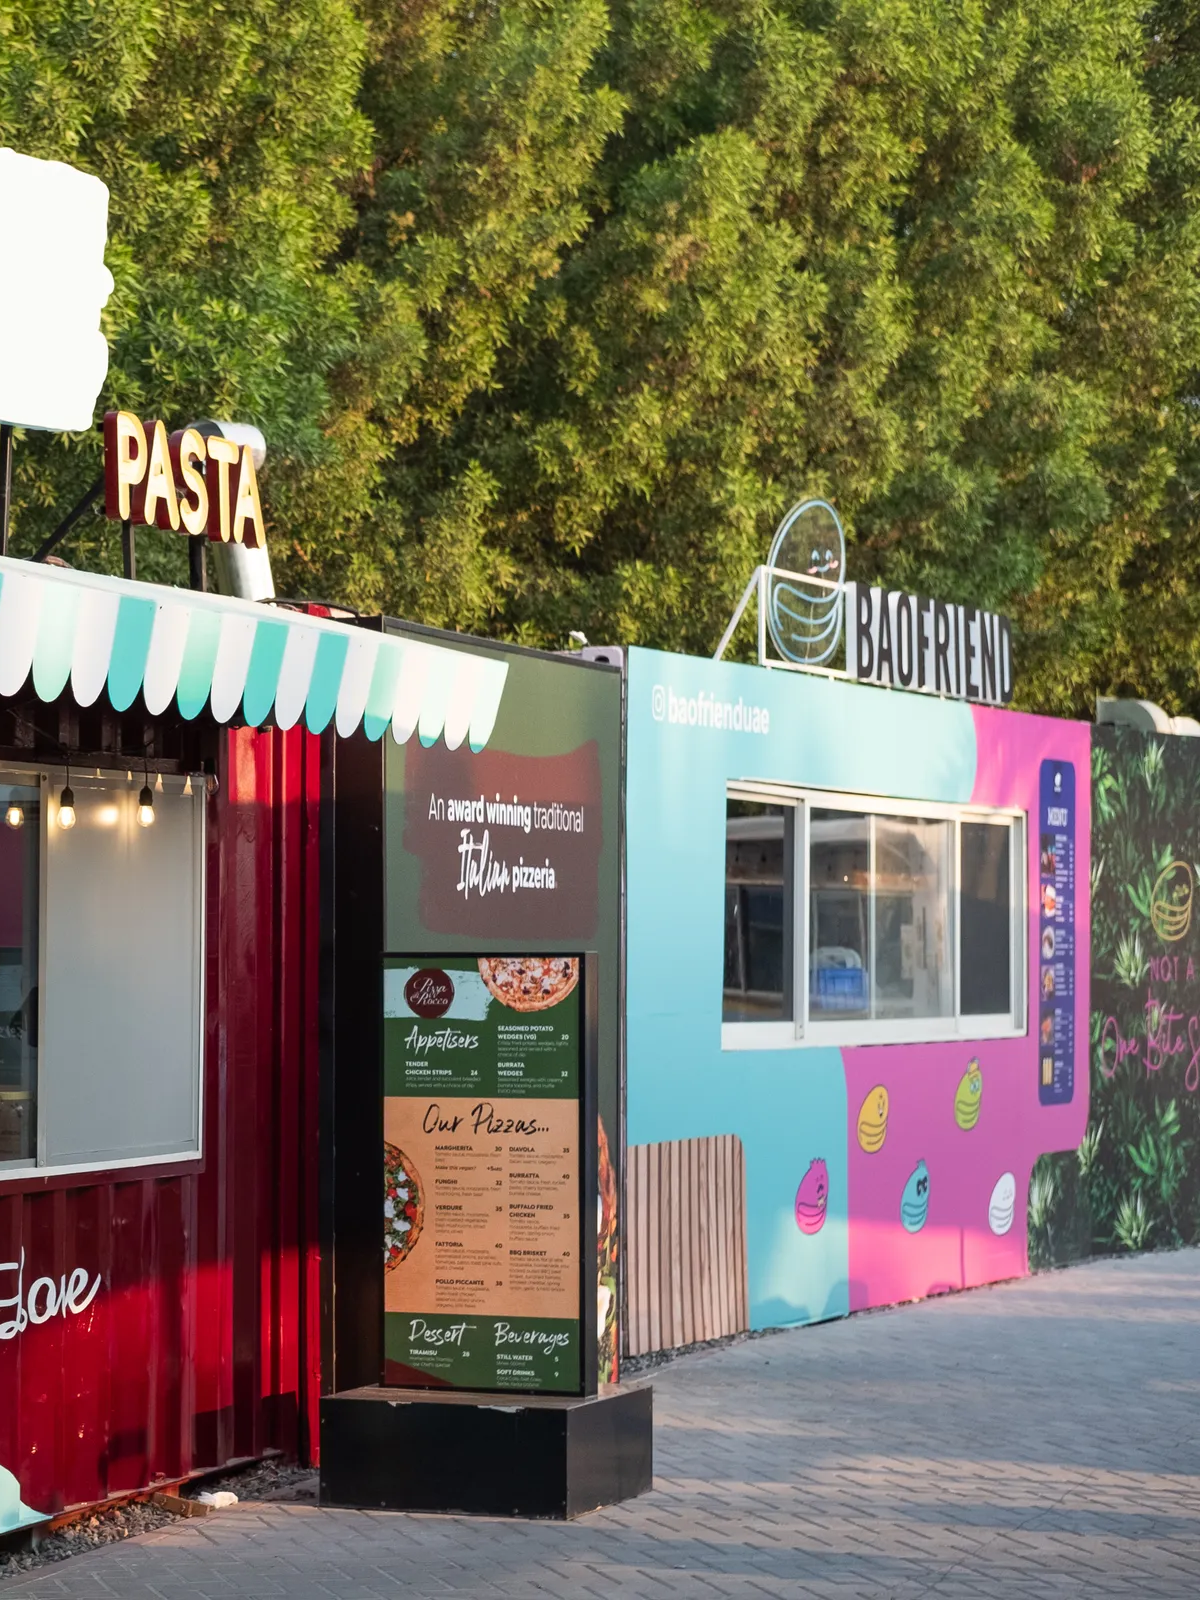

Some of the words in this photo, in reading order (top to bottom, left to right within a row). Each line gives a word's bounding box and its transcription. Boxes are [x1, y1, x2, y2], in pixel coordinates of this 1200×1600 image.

[104, 411, 266, 549] PASTA
[854, 583, 1013, 704] BAOFRIEND
[428, 792, 445, 821] An
[447, 794, 485, 824] award
[486, 792, 532, 834] winning
[533, 801, 584, 833] traditional
[456, 828, 510, 900] Italian
[1150, 955, 1179, 982] NOT
[1186, 955, 1195, 981] A
[413, 977, 447, 998] Pizza
[404, 1024, 480, 1056] Appetisers
[523, 1033, 537, 1041] (VG)
[560, 1070, 569, 1078] 32
[422, 1103, 464, 1134] Our
[471, 1102, 549, 1135] Pizzas...
[407, 1318, 477, 1347] Dessert
[493, 1321, 570, 1355] Beverages
[496, 1353, 513, 1361] STILL
[513, 1353, 533, 1361] WATER
[496, 1368, 512, 1376] SOFT
[512, 1369, 535, 1377] DRINKS
